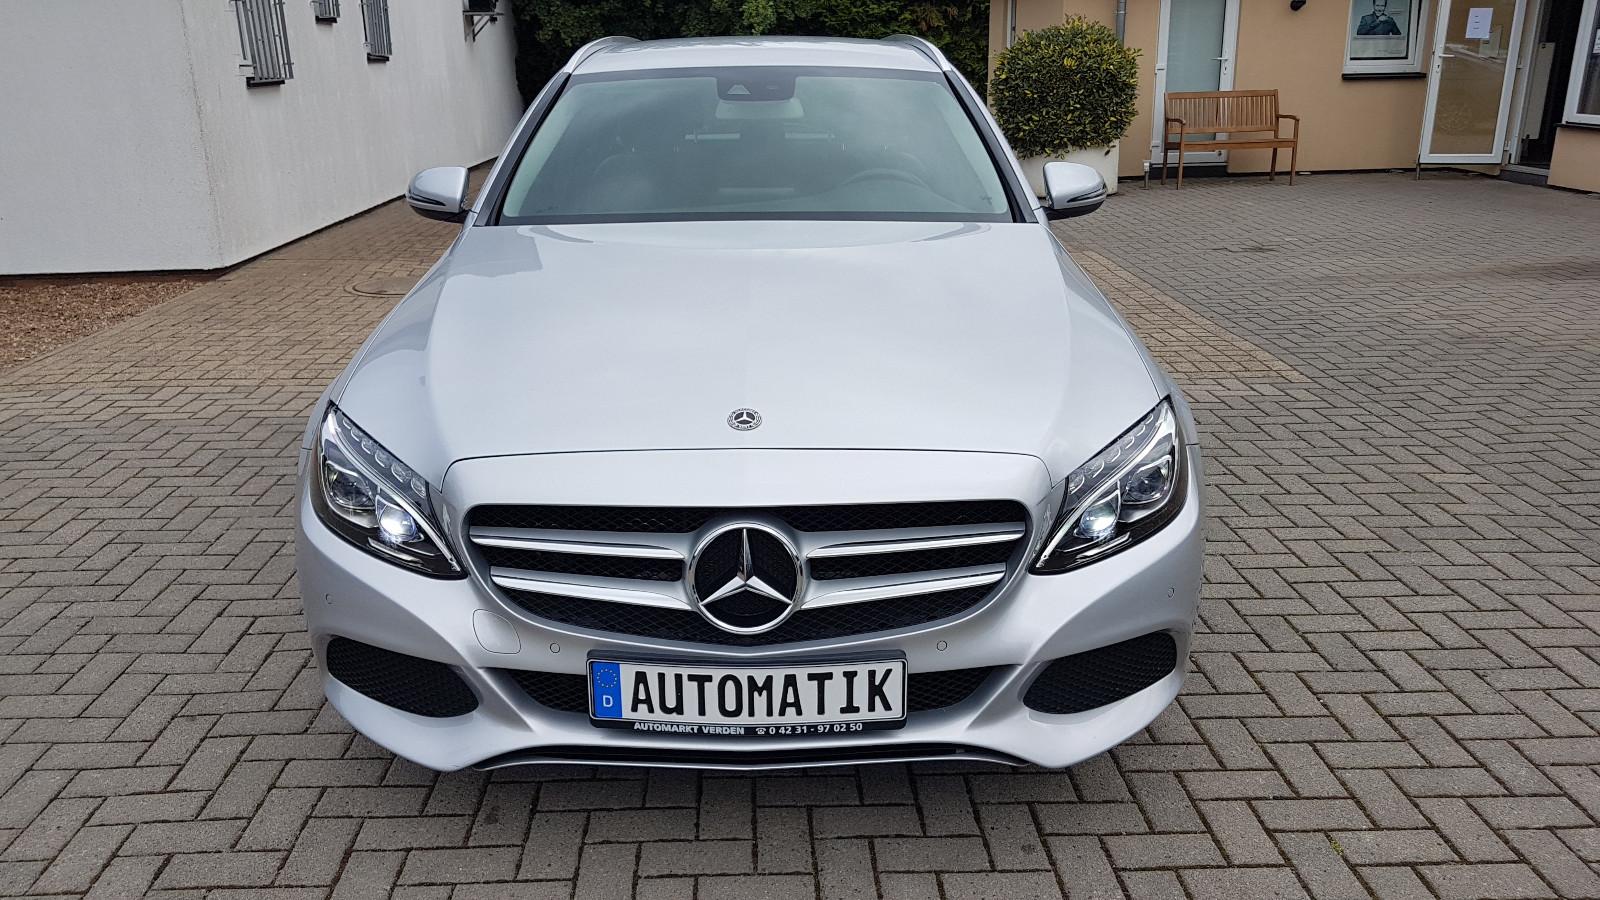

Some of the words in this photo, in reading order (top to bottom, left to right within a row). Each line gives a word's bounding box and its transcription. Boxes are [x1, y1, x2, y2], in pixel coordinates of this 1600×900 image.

[630, 669, 893, 718] AUTOMATIK
[602, 695, 614, 708] D
[633, 722, 699, 733] AUTOMARKT
[701, 726, 745, 735] VERDEN
[768, 726, 776, 735] 0
[778, 726, 792, 735] 42
[794, 725, 808, 734] 31
[817, 724, 830, 733] 97
[833, 723, 847, 732] 02
[849, 722, 863, 731] 50
